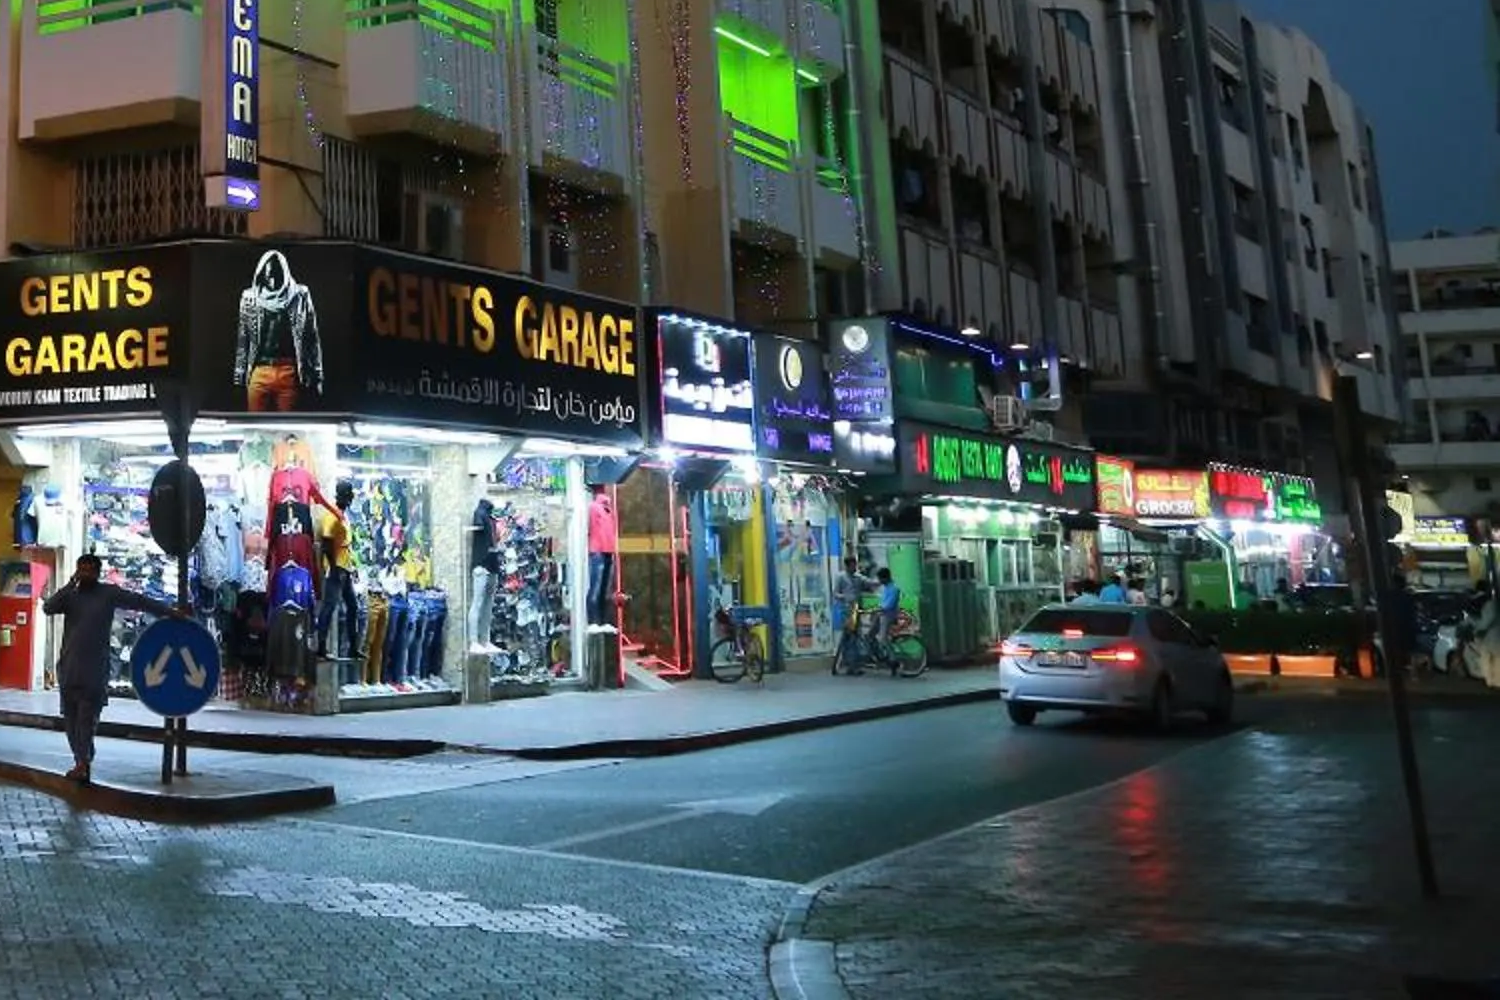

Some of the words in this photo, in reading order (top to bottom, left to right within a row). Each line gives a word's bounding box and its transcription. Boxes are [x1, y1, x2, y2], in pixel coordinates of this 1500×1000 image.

[227, 133, 258, 165] HOTEL
[20, 265, 154, 317] GENTS
[368, 267, 496, 353] GENTS
[514, 294, 636, 377] GARAGE
[4, 327, 170, 377] GARAGE
[63, 386, 101, 403] TEXTILE
[103, 383, 147, 401] TRADING
